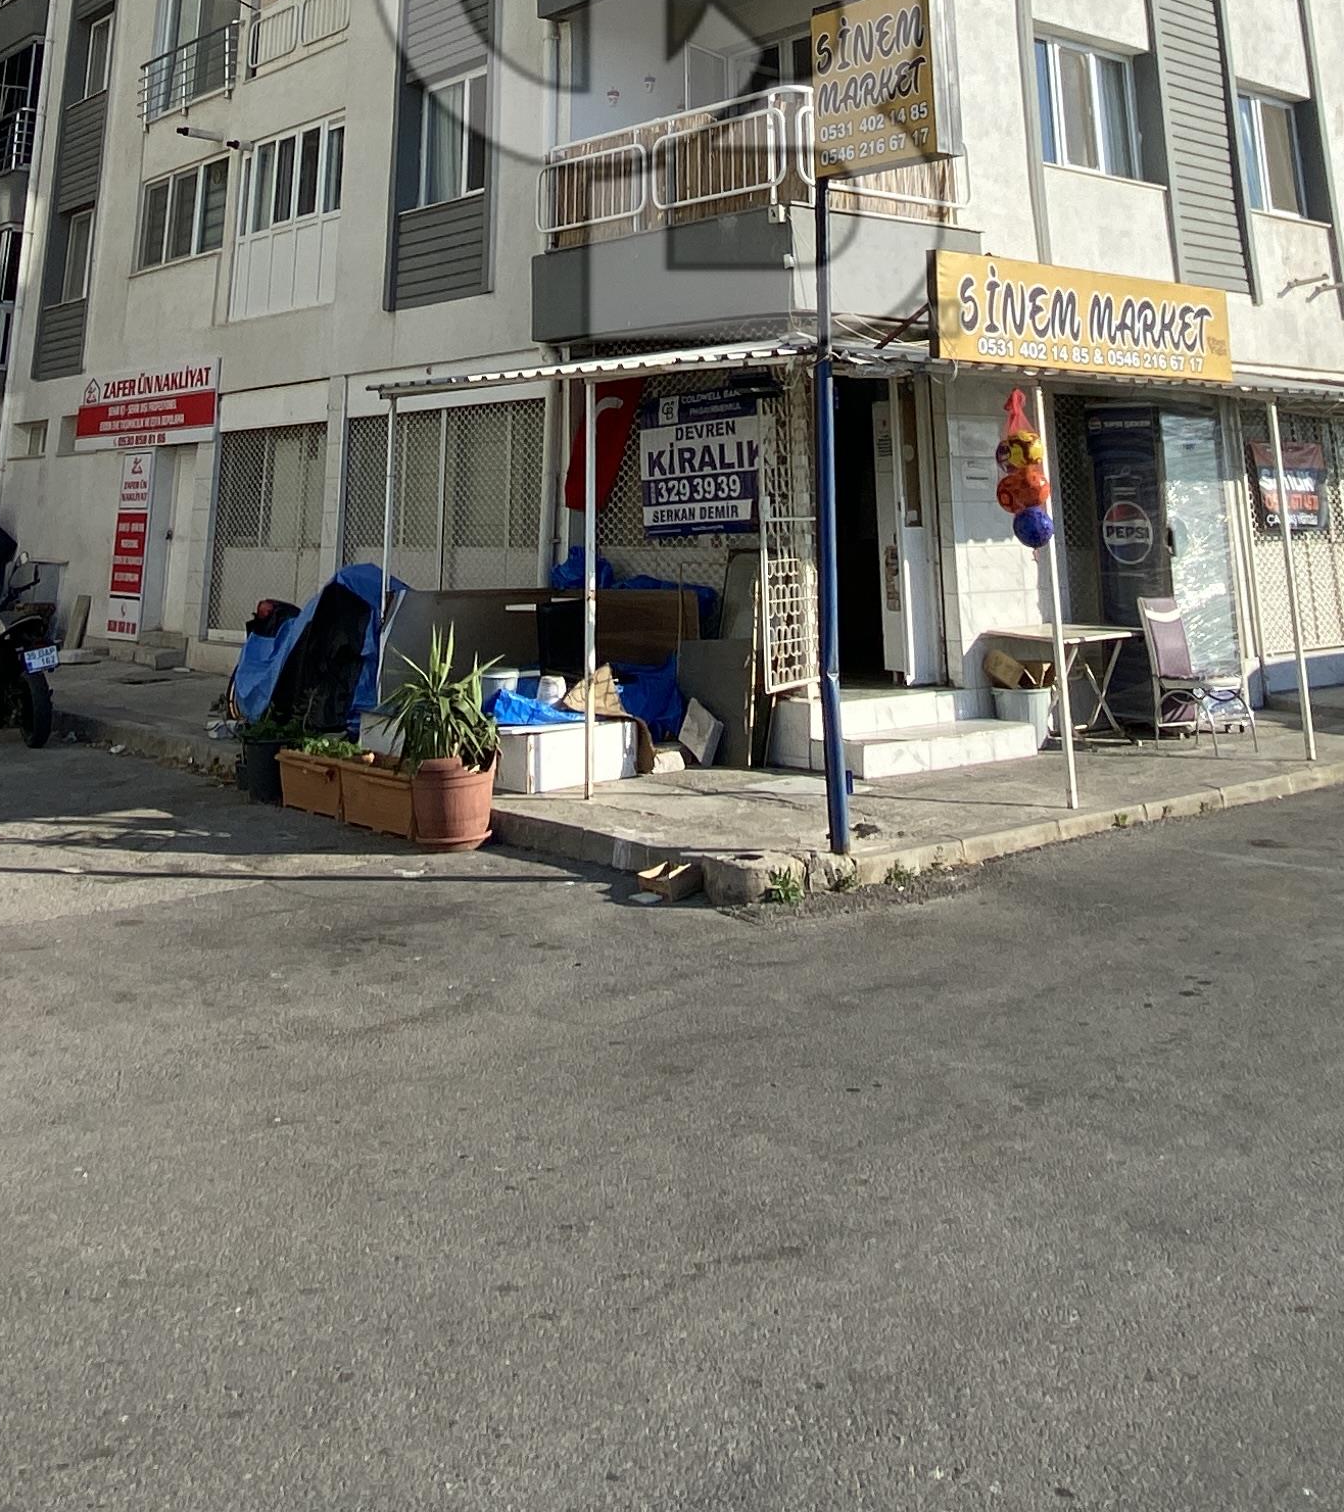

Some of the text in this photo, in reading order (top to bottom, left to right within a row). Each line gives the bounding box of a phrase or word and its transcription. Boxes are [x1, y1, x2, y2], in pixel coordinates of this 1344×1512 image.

[816, 4, 925, 76] SİNEM
[817, 56, 926, 119] MARKET
[820, 102, 928, 142] 0531 402 14 85
[821, 128, 929, 166] 0546 216 67 17
[959, 264, 1212, 355] SİNEM MARKET
[978, 337, 1205, 373] 0531 402 14 85 & 0546 216 67 17
[103, 365, 211, 399] ZAFER ÜN NAKLİYAT
[675, 420, 736, 441] DEVREN
[658, 479, 690, 502] 329
[652, 502, 739, 523] SERKAN DEMİR
[1106, 526, 1150, 538] PEPSI
